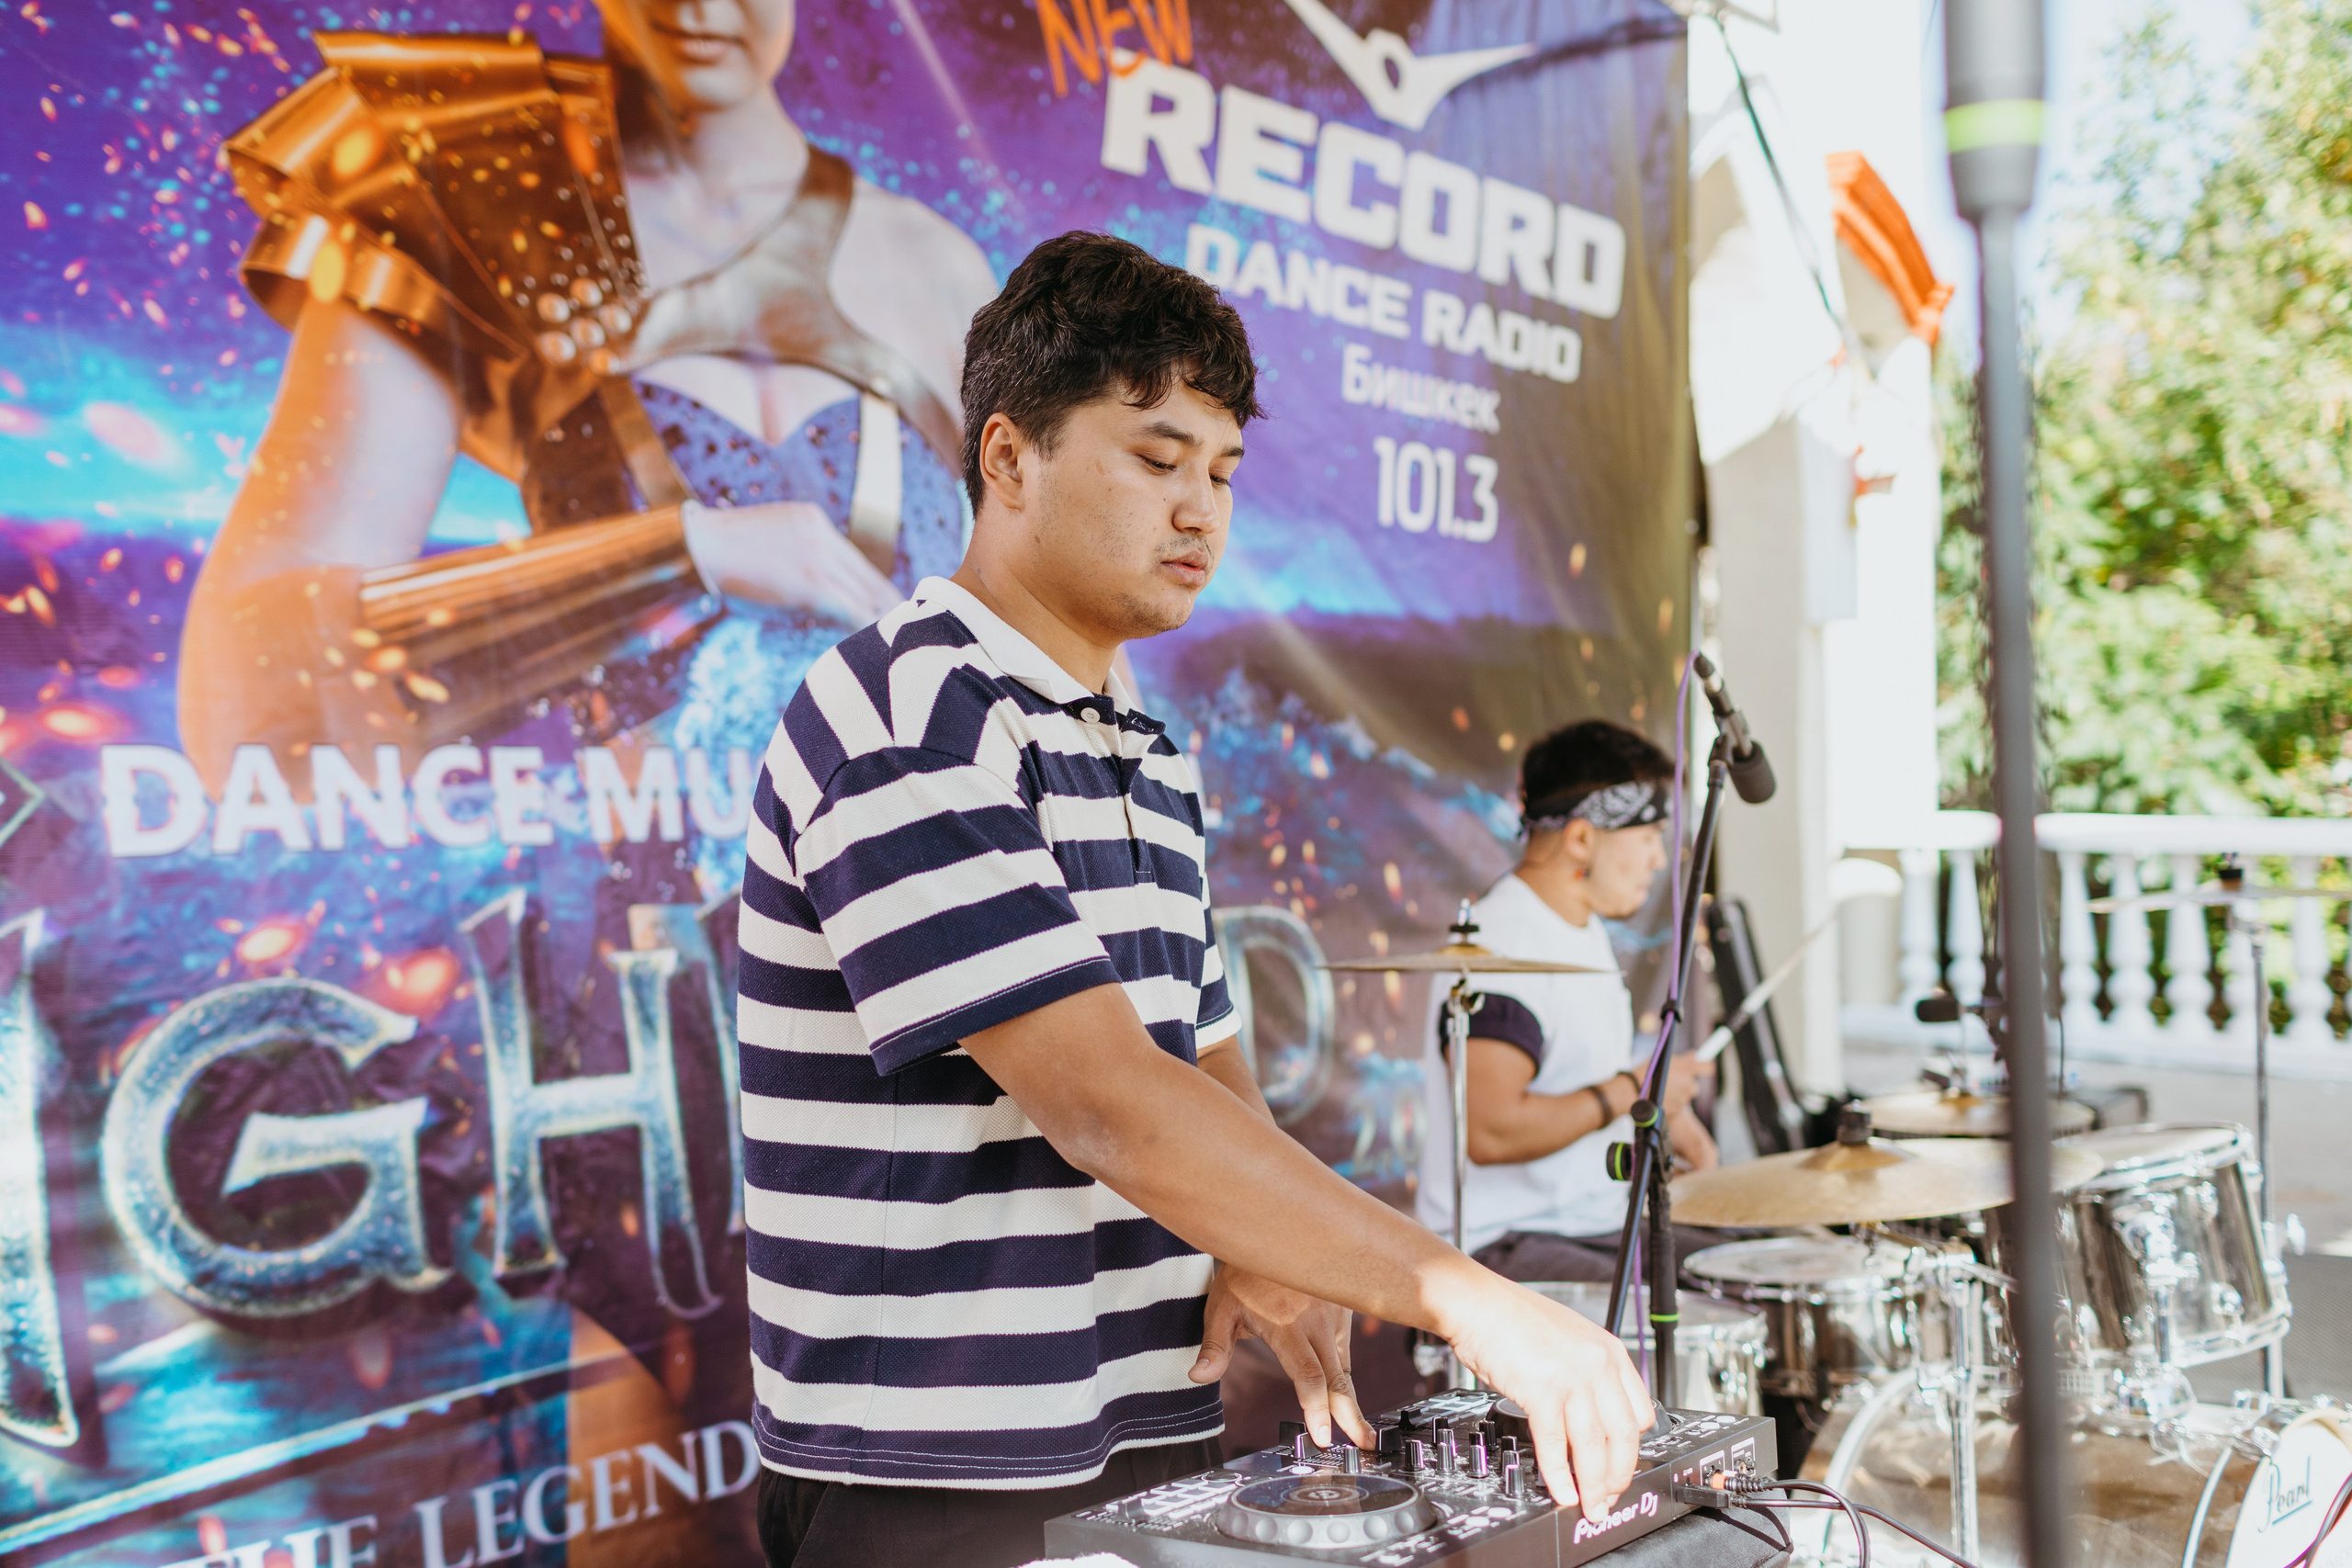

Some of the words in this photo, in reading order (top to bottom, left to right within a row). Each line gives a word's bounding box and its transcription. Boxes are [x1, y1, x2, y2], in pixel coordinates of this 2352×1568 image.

[1101, 46, 1627, 320] RECORD
[1186, 222, 1411, 339] DANCE
[1422, 290, 1583, 384] RADIO
[1342, 344, 1500, 434] Бишкек
[1374, 437, 1498, 543] 101.3
[101, 744, 553, 857] DANCE
[582, 746, 766, 843] MU
[413, 1420, 761, 1568] LEGEND
[2257, 1454, 2312, 1534] Pearl
